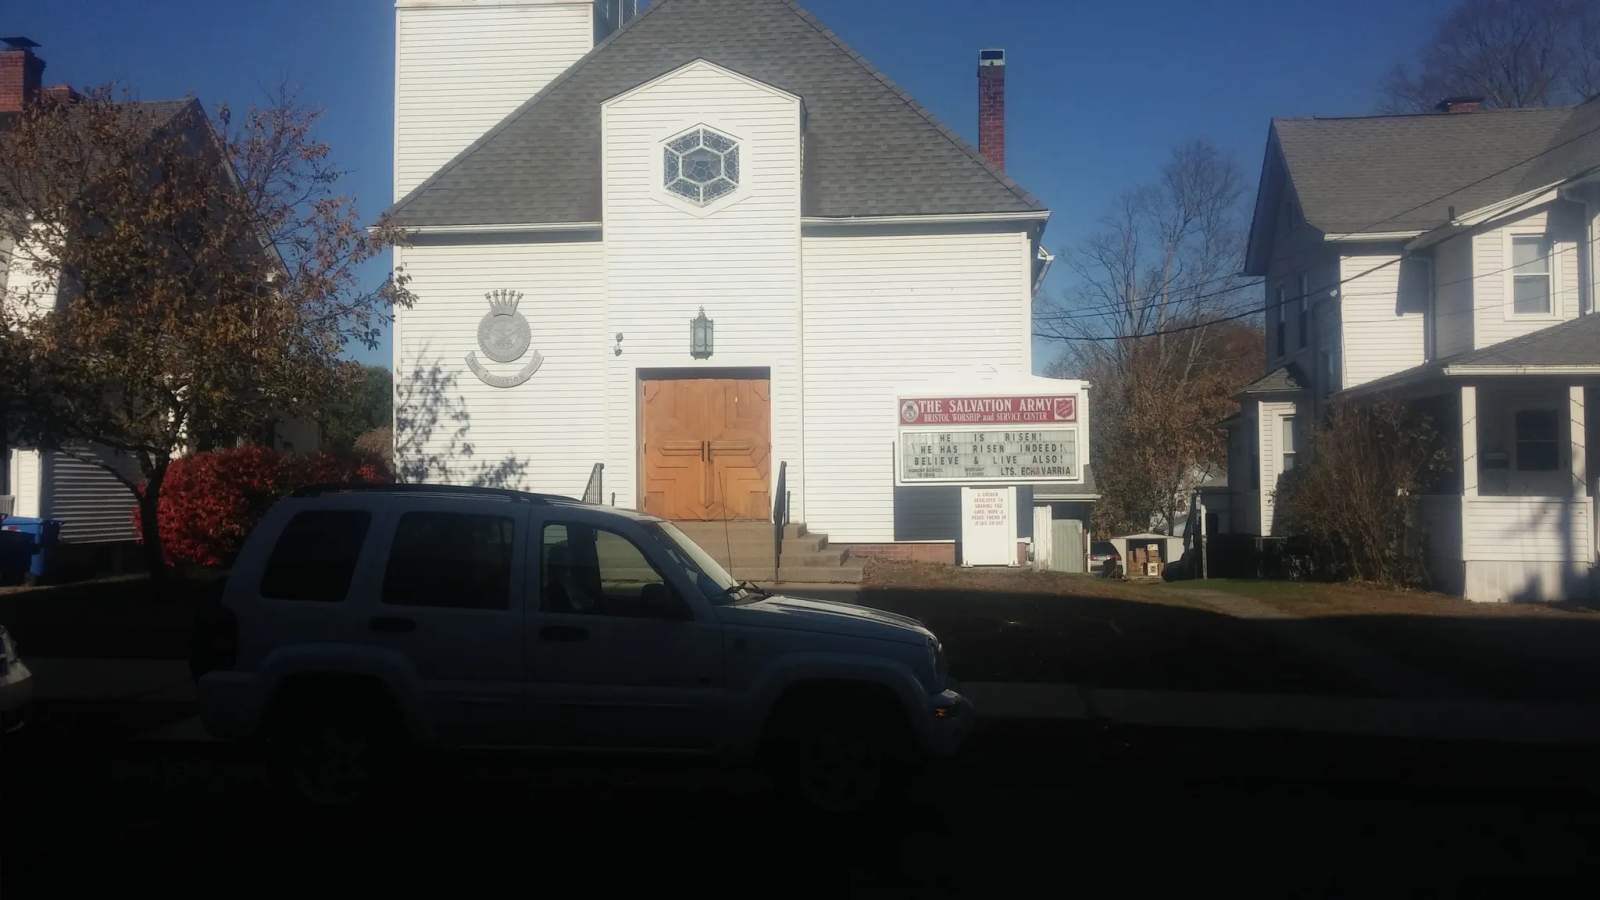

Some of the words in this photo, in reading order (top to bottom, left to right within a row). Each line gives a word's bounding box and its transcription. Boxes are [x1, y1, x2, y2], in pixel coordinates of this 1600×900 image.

[919, 399, 943, 413] THE
[949, 399, 1012, 413] SALVATION
[1020, 398, 1053, 412] ARMY
[952, 412, 981, 422] WORSHIP
[996, 412, 1021, 421] SERVICE
[1023, 412, 1048, 421] CENTER
[940, 433, 951, 442] HE
[974, 433, 985, 442] IS
[1005, 432, 1042, 442] RISEN!
[920, 445, 932, 454] HE
[940, 445, 958, 454] HAS
[973, 444, 1005, 454] RISEN
[1020, 443, 1063, 453] INDEED!
[914, 456, 959, 466] BELIEVE
[974, 456, 979, 465] &
[993, 455, 1017, 465] LIVE
[1032, 455, 1063, 464] ALSO!
